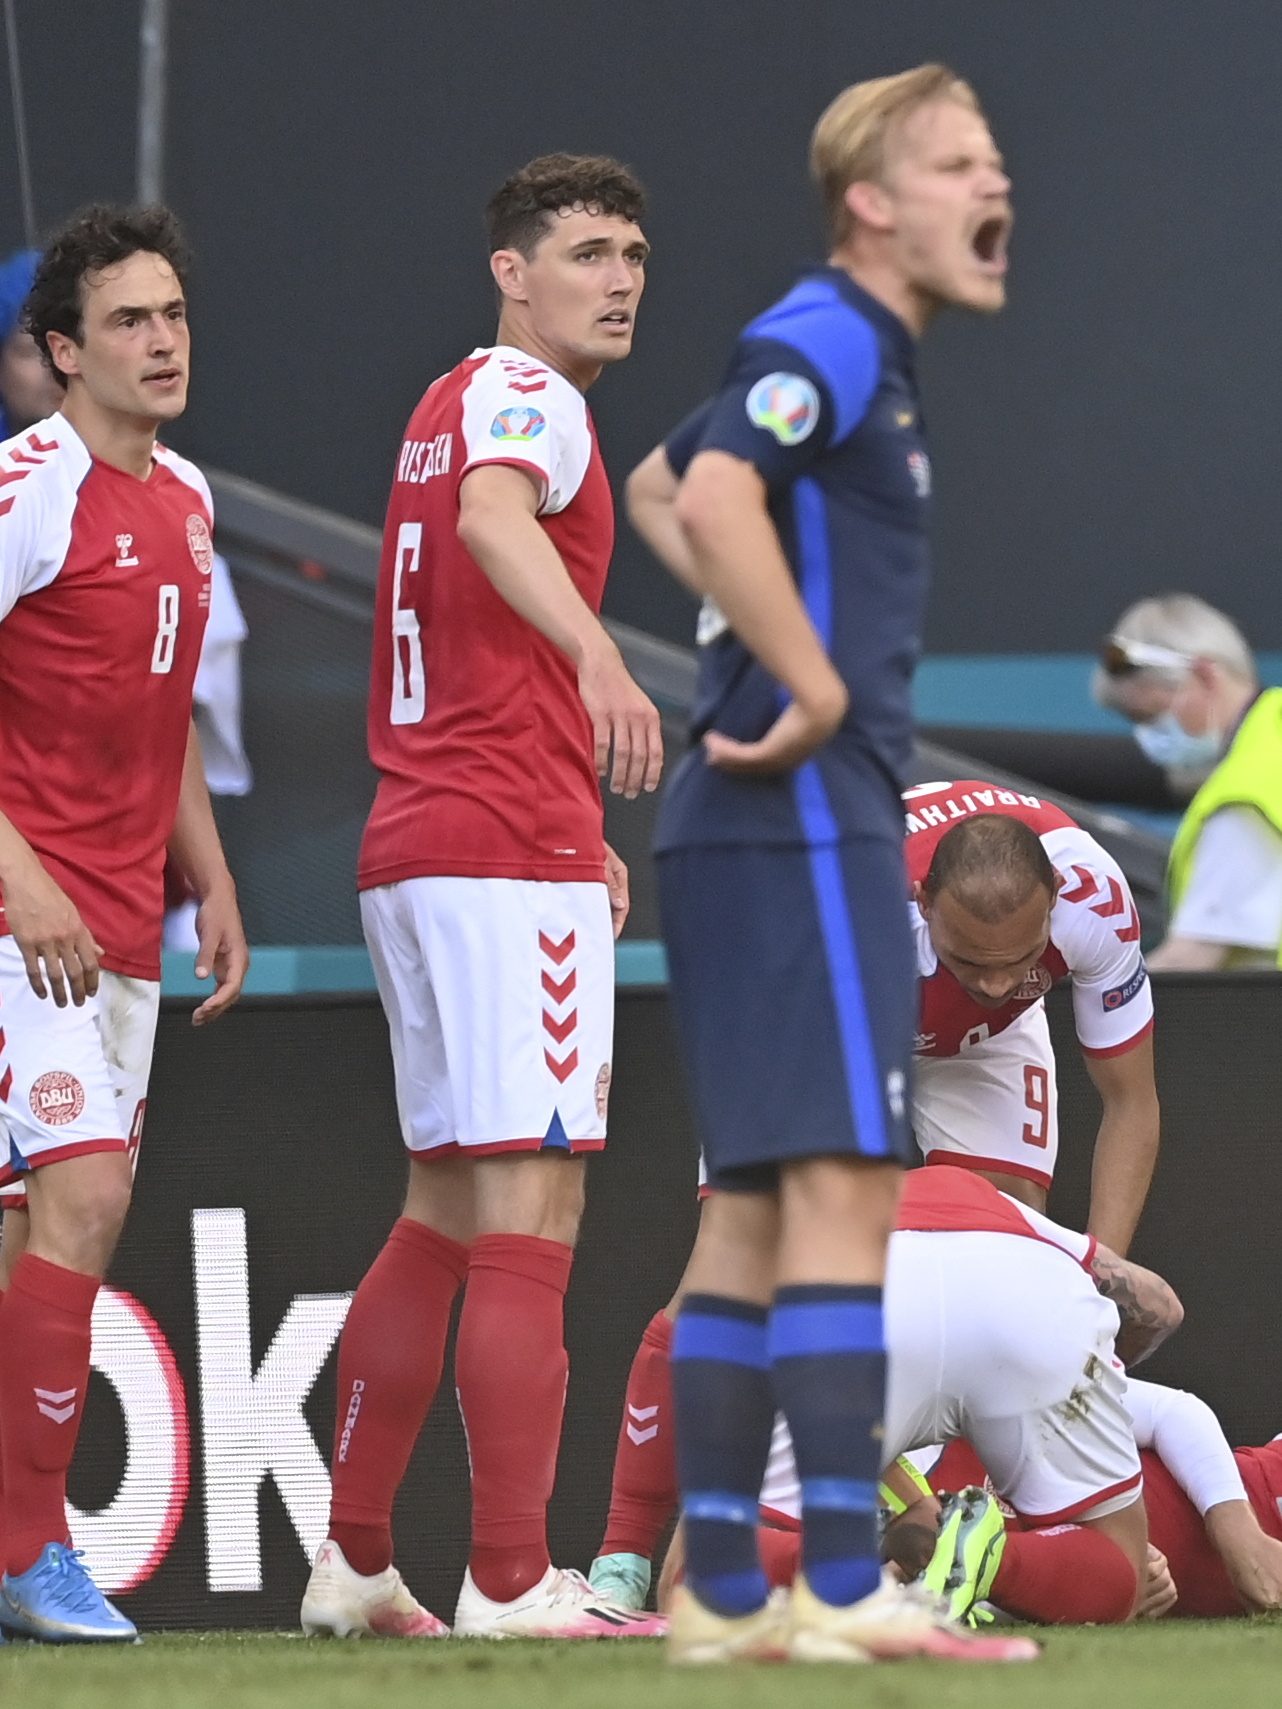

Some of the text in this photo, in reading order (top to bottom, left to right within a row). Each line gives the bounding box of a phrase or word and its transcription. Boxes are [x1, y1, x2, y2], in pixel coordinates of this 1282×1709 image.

[151, 584, 180, 674] 8
[390, 522, 426, 725] 6
[40, 1087, 74, 1109] DBU
[1023, 1065, 1048, 1149] 9
[338, 1379, 365, 1462] DANMARK
